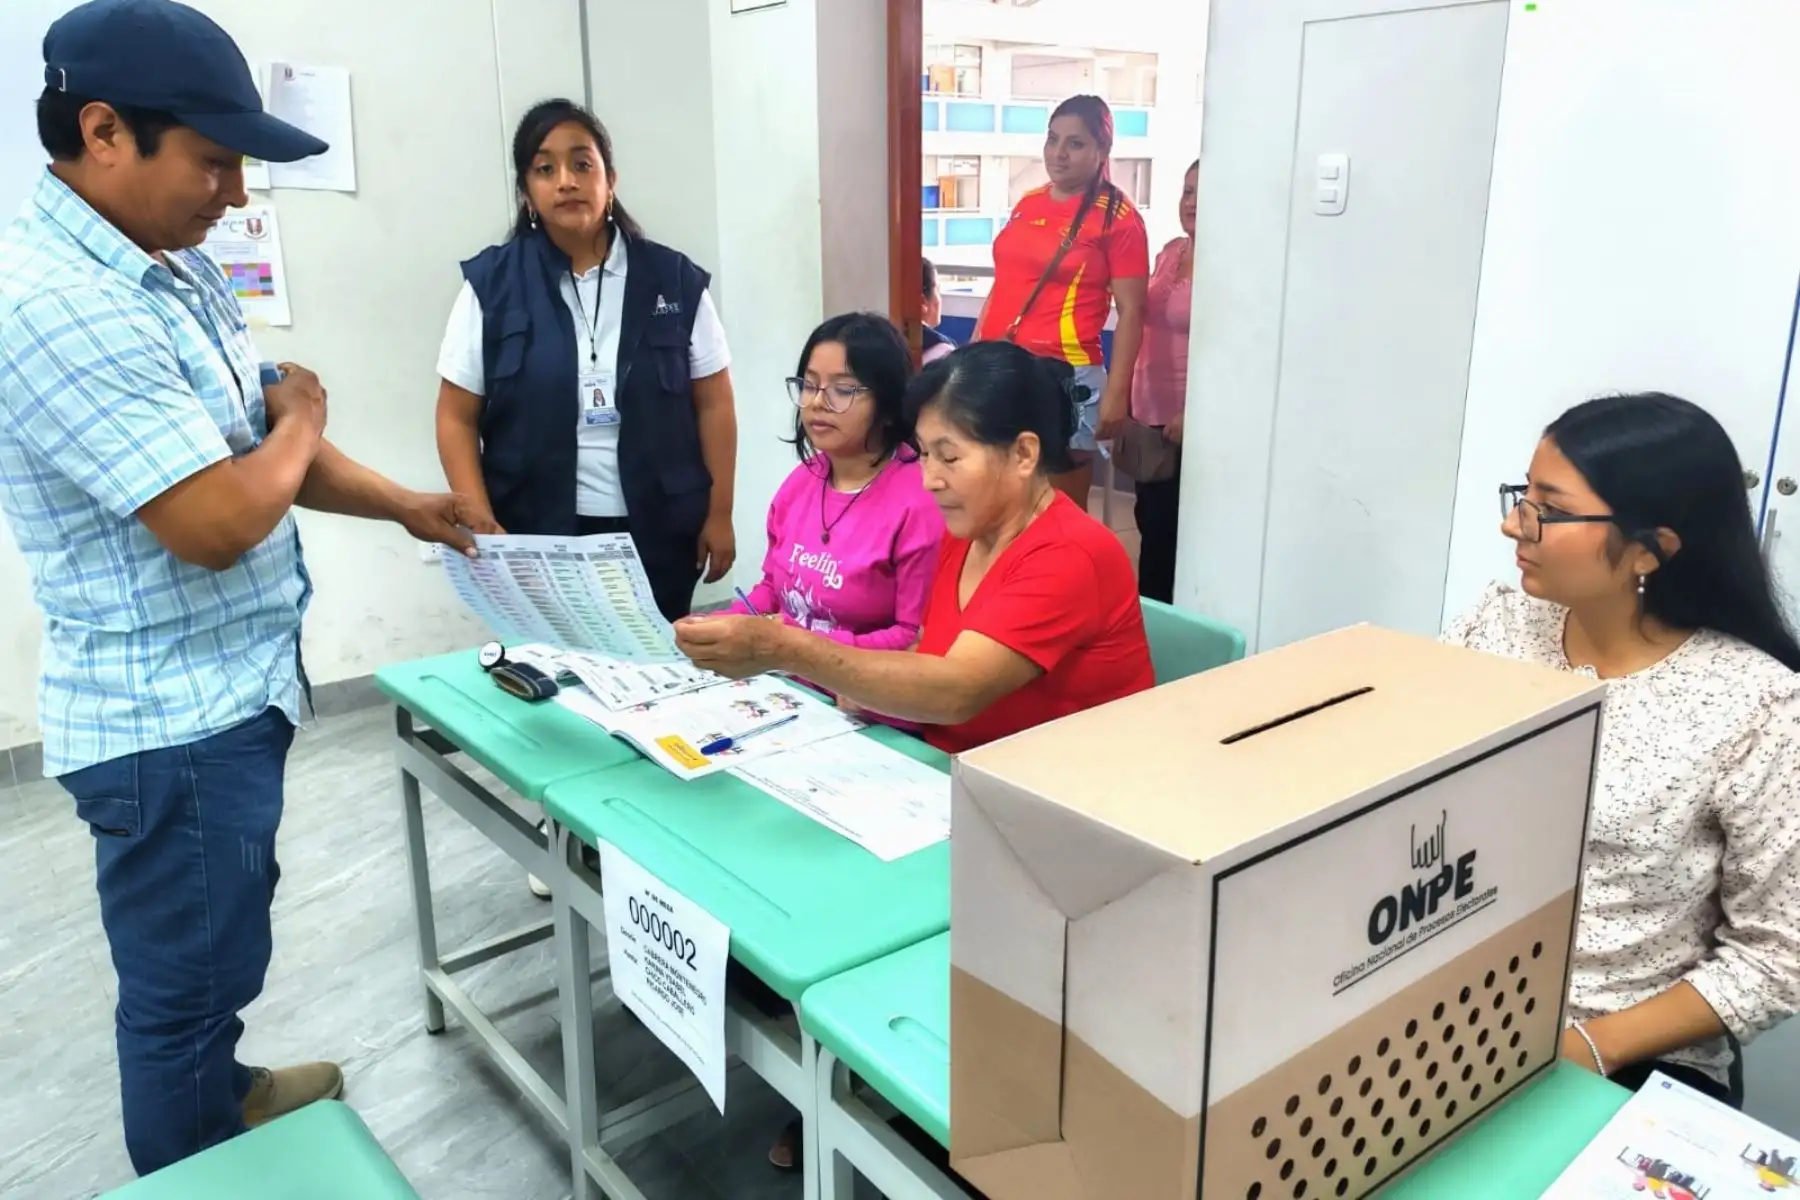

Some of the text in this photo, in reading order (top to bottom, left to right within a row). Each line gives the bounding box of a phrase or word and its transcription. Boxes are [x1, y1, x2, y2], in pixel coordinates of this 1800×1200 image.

[629, 896, 697, 971] 000002
[1333, 886, 1498, 987] Oficina Nacional de Procesos Electorales
[1368, 849, 1476, 946] ONPE
